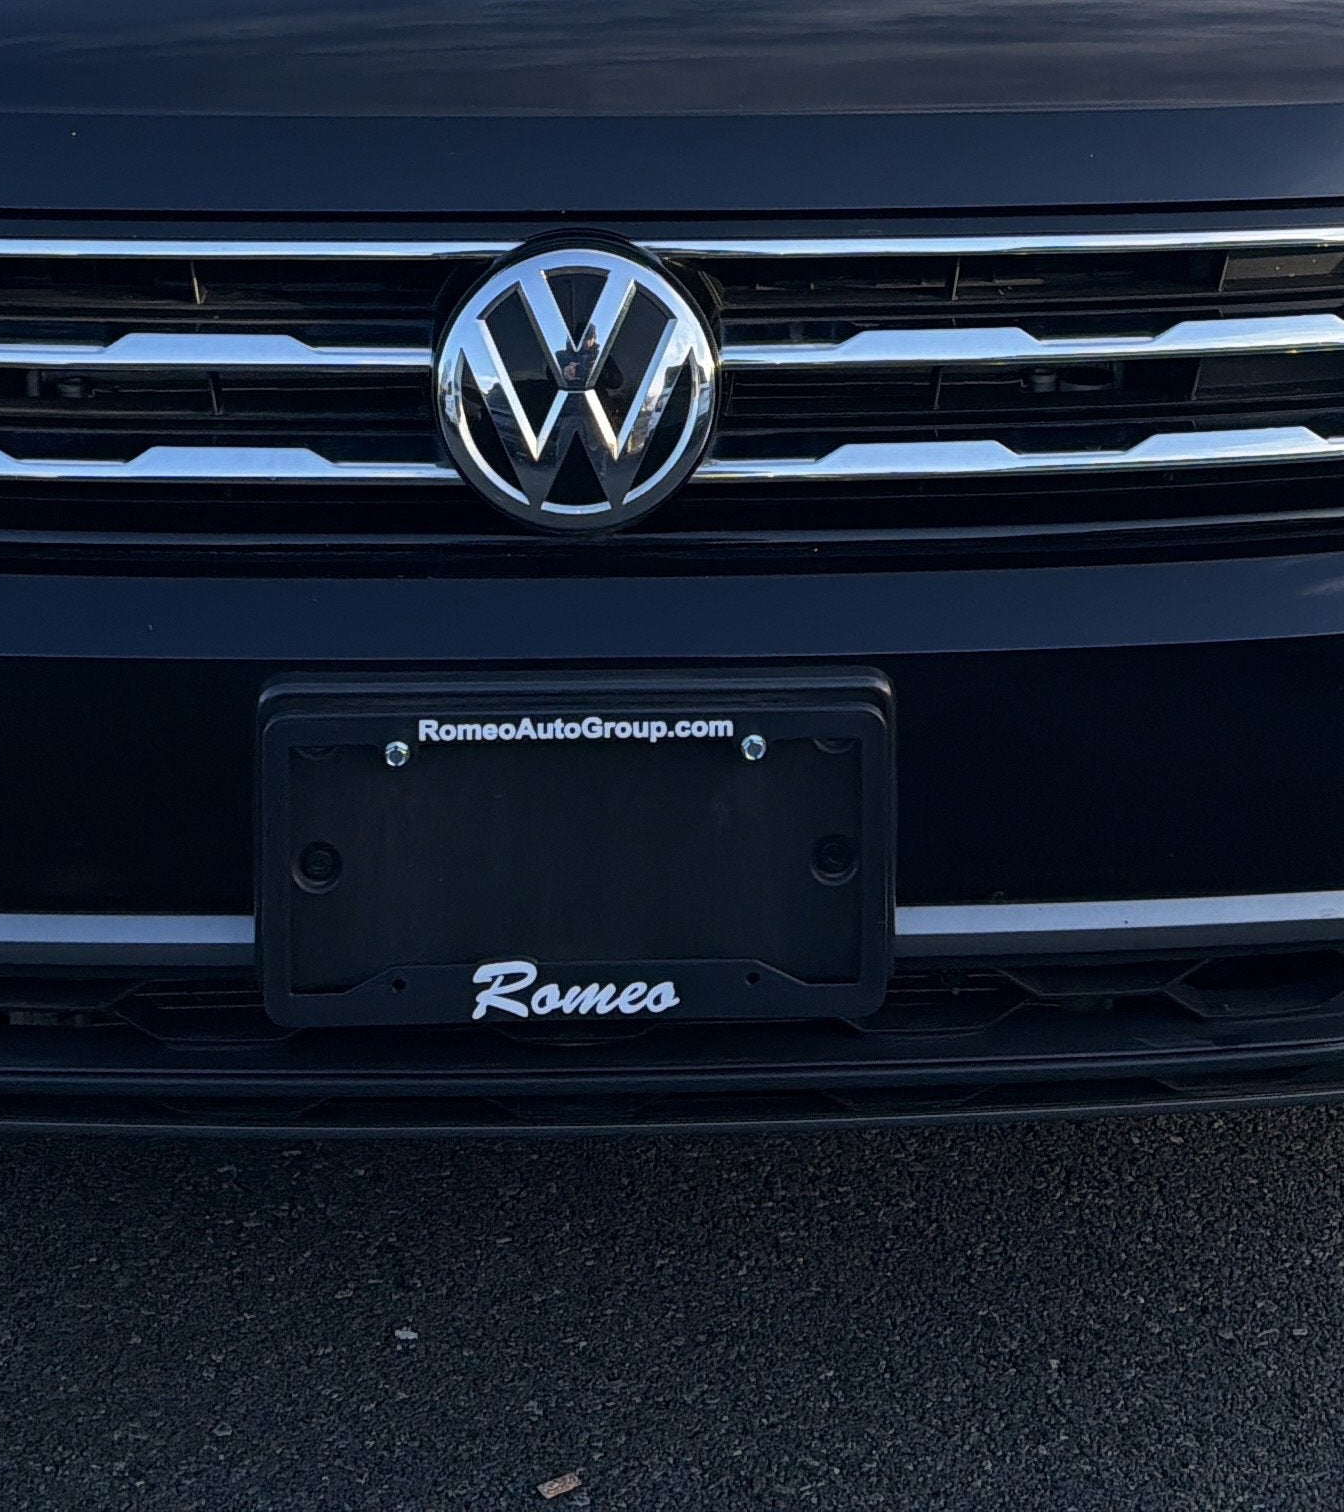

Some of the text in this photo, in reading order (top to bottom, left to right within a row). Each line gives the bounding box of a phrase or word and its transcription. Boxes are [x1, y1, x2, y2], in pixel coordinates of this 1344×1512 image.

[437, 248, 717, 530] VW
[417, 716, 734, 744] RomeoAutoGroup.com
[471, 960, 681, 1020] Romeo
